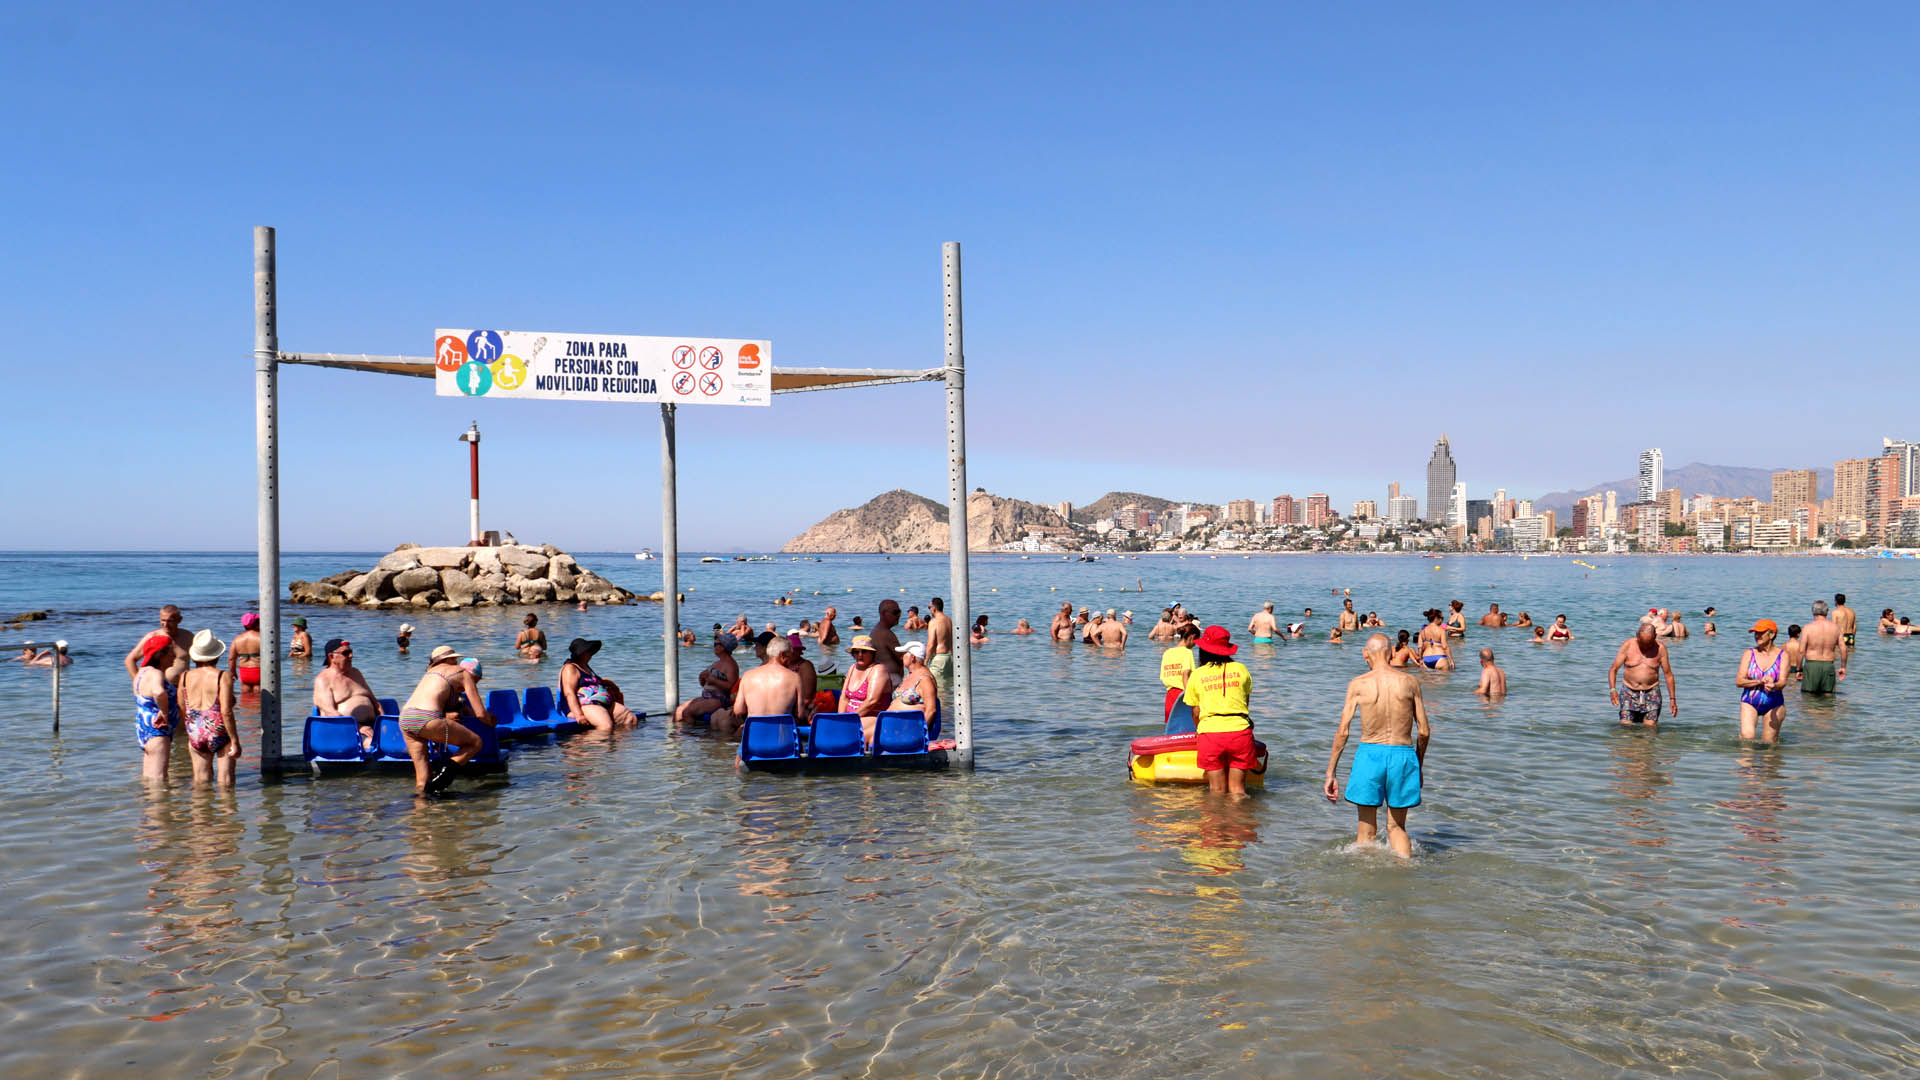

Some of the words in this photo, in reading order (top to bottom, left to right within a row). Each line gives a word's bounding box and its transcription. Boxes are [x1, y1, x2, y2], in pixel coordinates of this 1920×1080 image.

[566, 341, 595, 357] ZONA
[599, 342, 627, 358] PARA
[555, 358, 613, 375] PERSONAS
[617, 361, 638, 376] CON
[536, 375, 598, 392] MOVILIDAD
[602, 377, 657, 394] REDUCIDA
[1200, 672, 1241, 684] SOCORISTA
